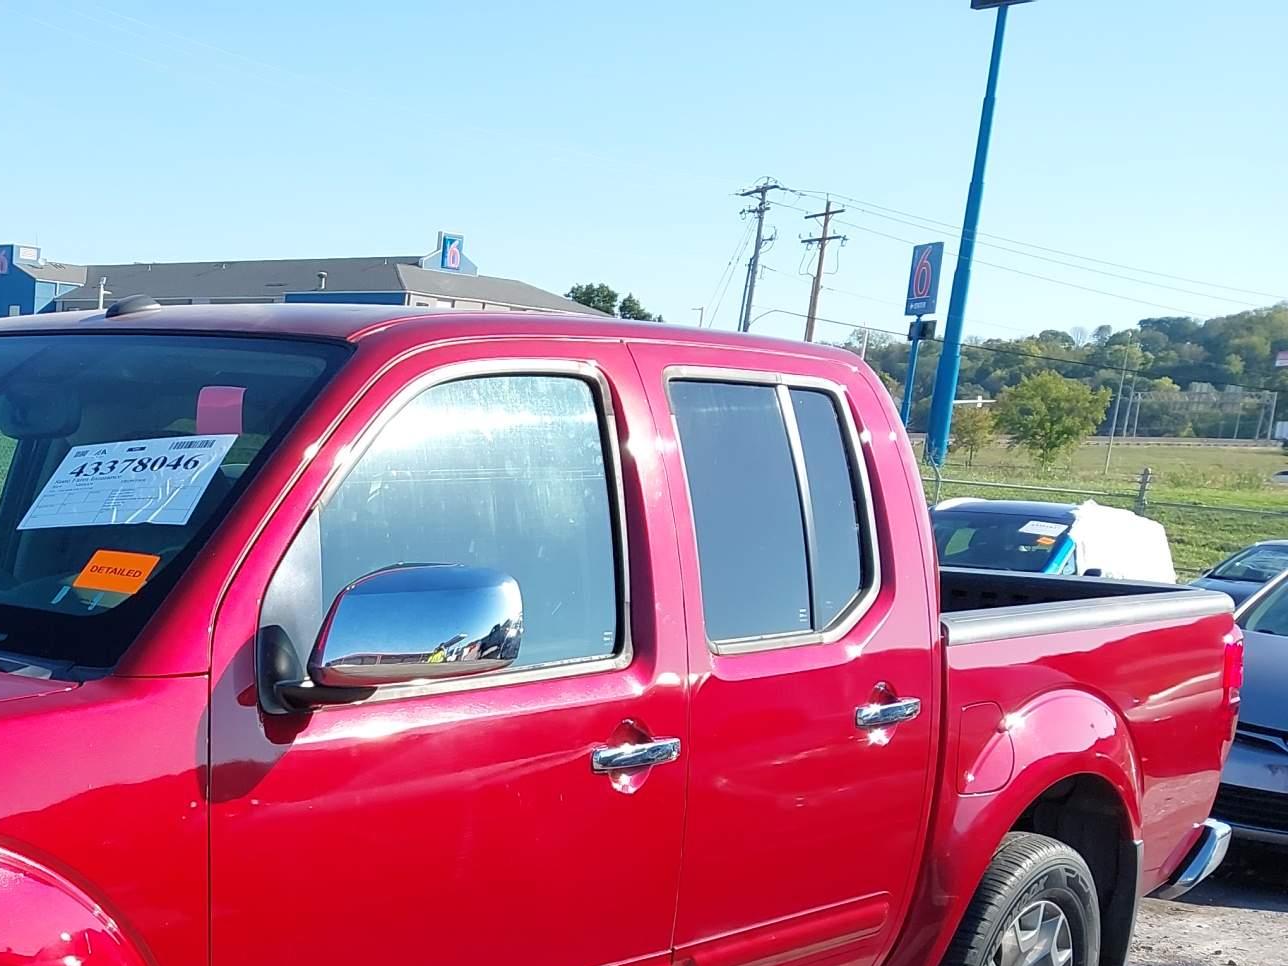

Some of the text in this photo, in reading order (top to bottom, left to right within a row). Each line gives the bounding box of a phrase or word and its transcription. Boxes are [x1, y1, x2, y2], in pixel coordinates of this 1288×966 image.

[447, 240, 460, 268] 6
[913, 245, 932, 298] 6
[69, 454, 204, 478] 43378046
[89, 564, 143, 579] DETAILED
